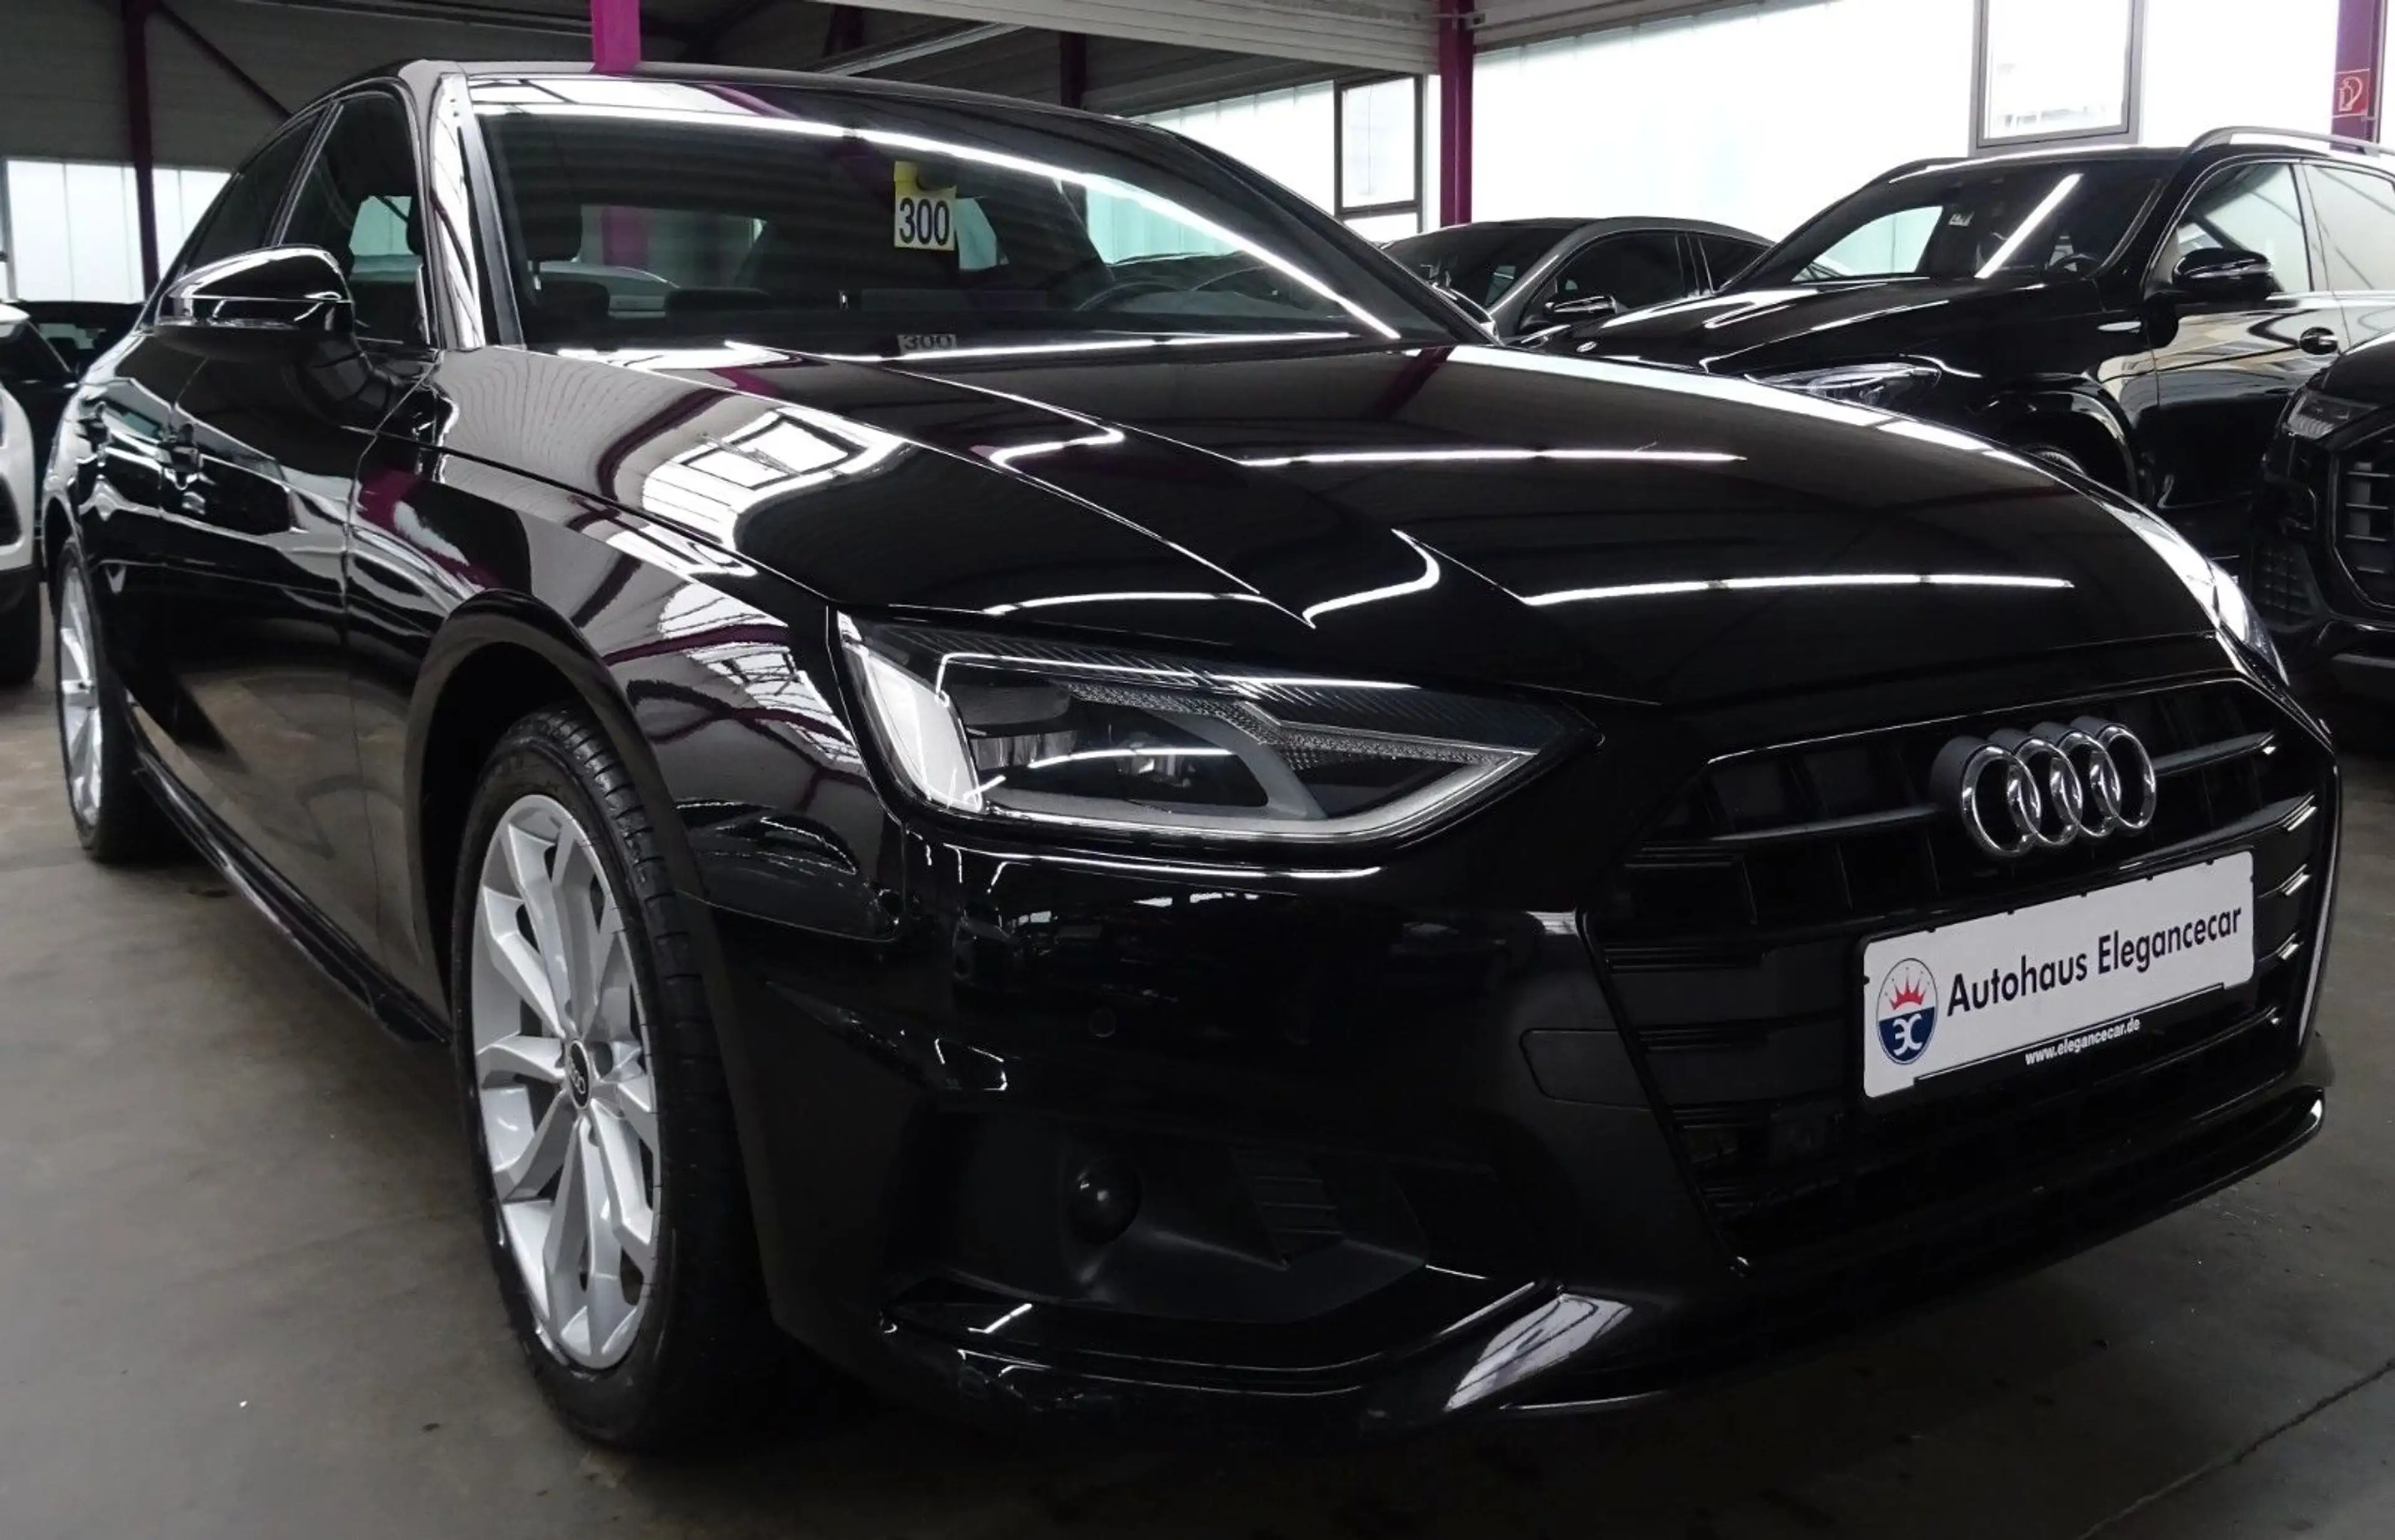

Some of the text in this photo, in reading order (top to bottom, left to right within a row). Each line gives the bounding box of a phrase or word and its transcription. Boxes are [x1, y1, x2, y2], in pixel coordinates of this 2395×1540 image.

[899, 198, 950, 246] 300
[1947, 906, 2242, 1017] Autohaus Elegancecar
[2025, 1017, 2141, 1065] www.elegancecar.de
